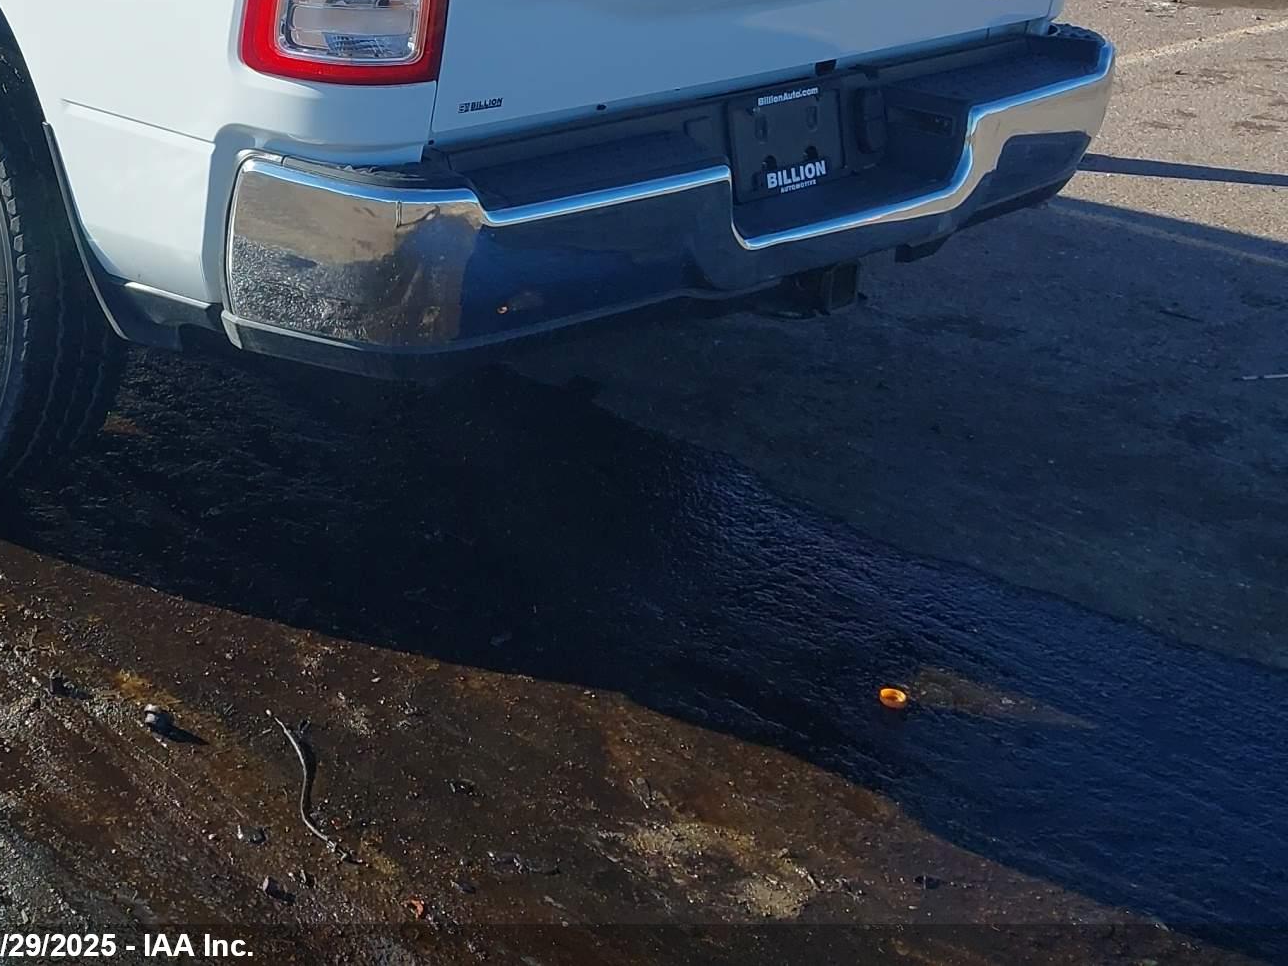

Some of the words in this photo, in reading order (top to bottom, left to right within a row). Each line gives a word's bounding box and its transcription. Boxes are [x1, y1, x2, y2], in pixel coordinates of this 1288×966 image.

[470, 97, 503, 112] BILLION
[757, 87, 819, 107] BillionAuto.com
[766, 160, 827, 189] BILLION
